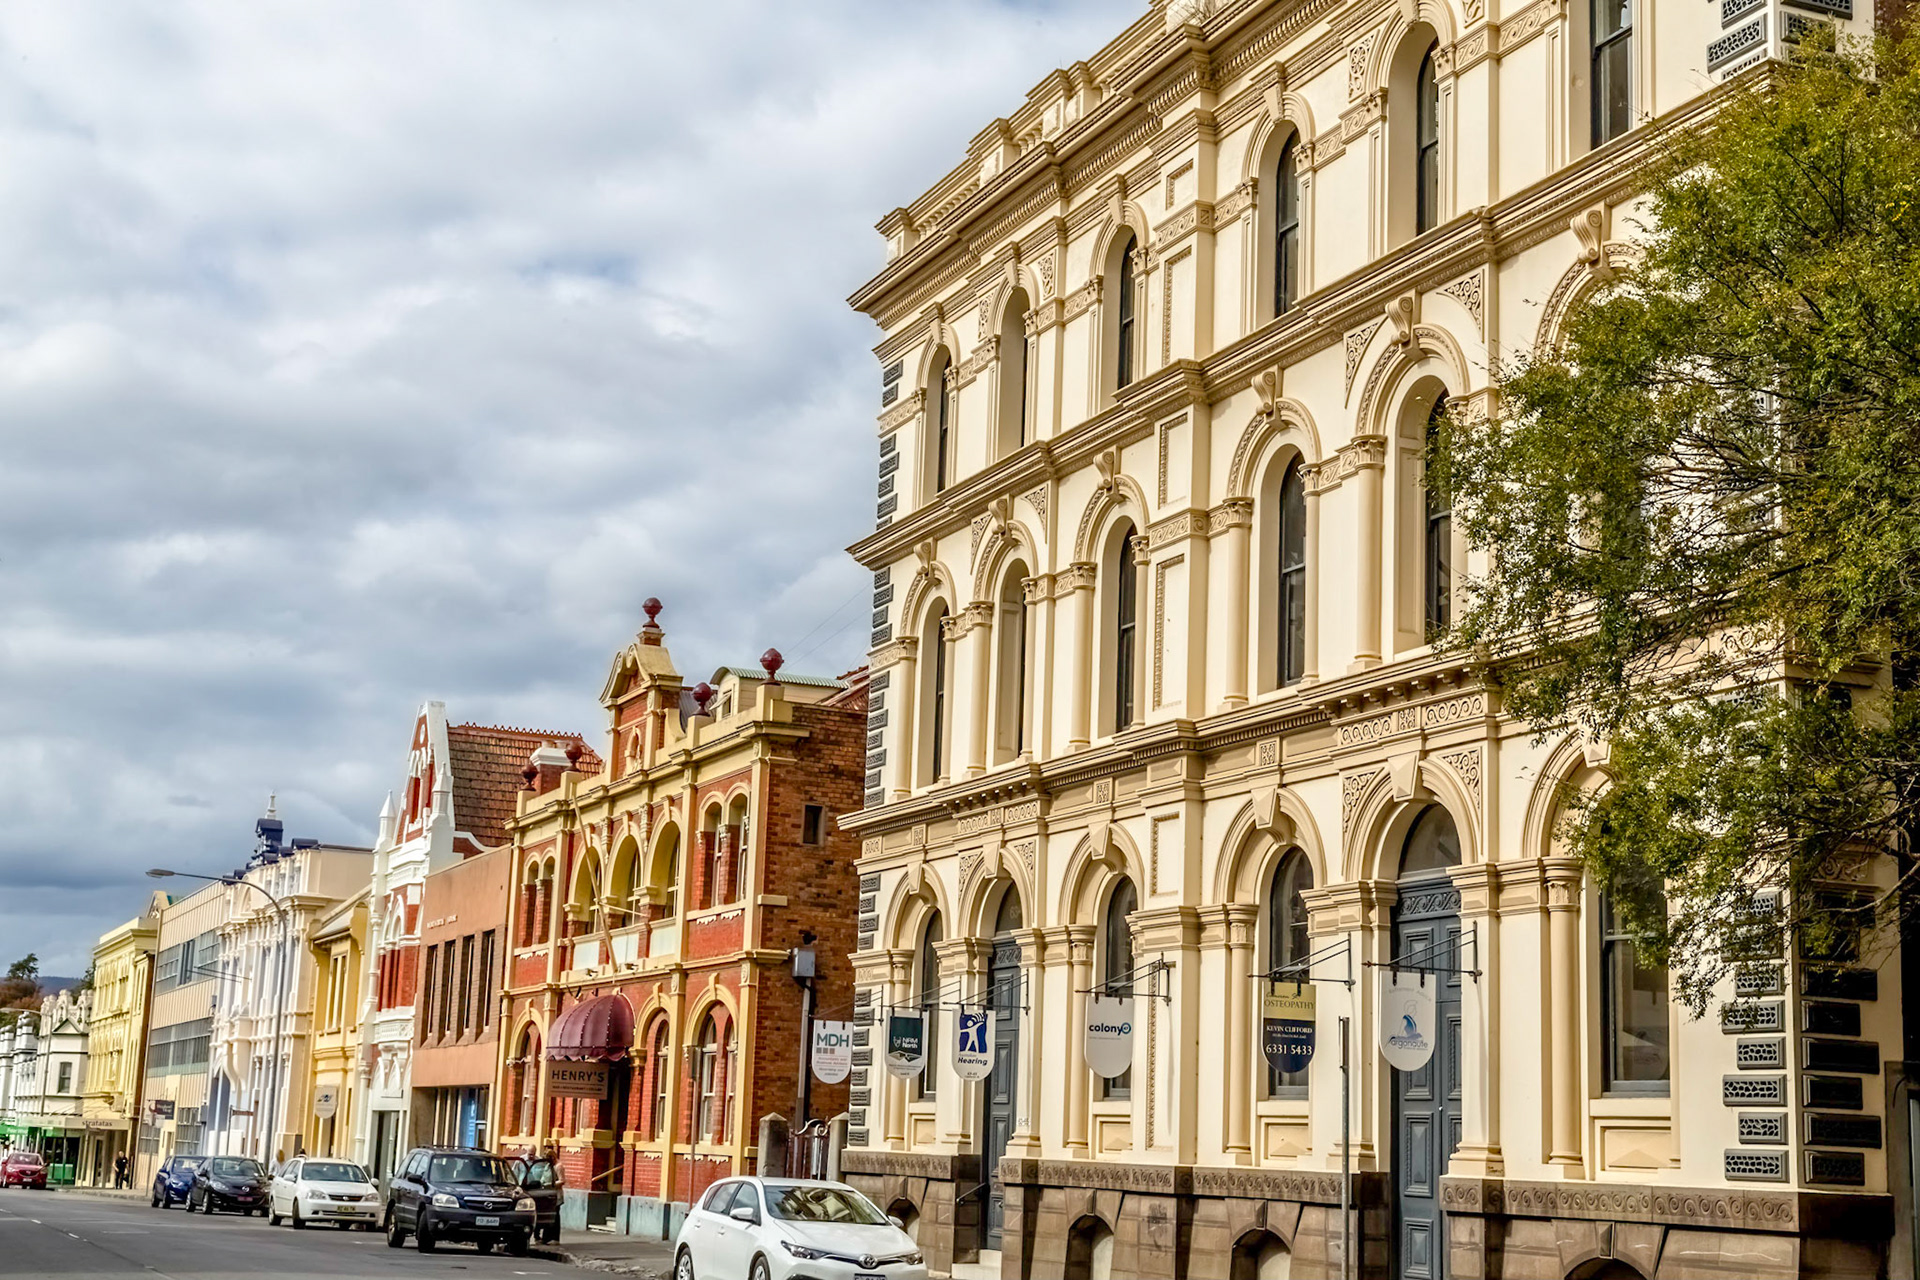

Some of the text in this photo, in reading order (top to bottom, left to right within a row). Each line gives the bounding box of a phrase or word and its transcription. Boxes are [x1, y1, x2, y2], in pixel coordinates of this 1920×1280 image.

[1264, 1000, 1315, 1010] OSTEOPATHY
[1285, 1026, 1313, 1034] CLIFFORD
[816, 1033, 849, 1047] MDH
[1265, 1044, 1314, 1056] 6331 5433
[958, 1057, 988, 1066] Hearing
[552, 1069, 605, 1083] HENRY'S
